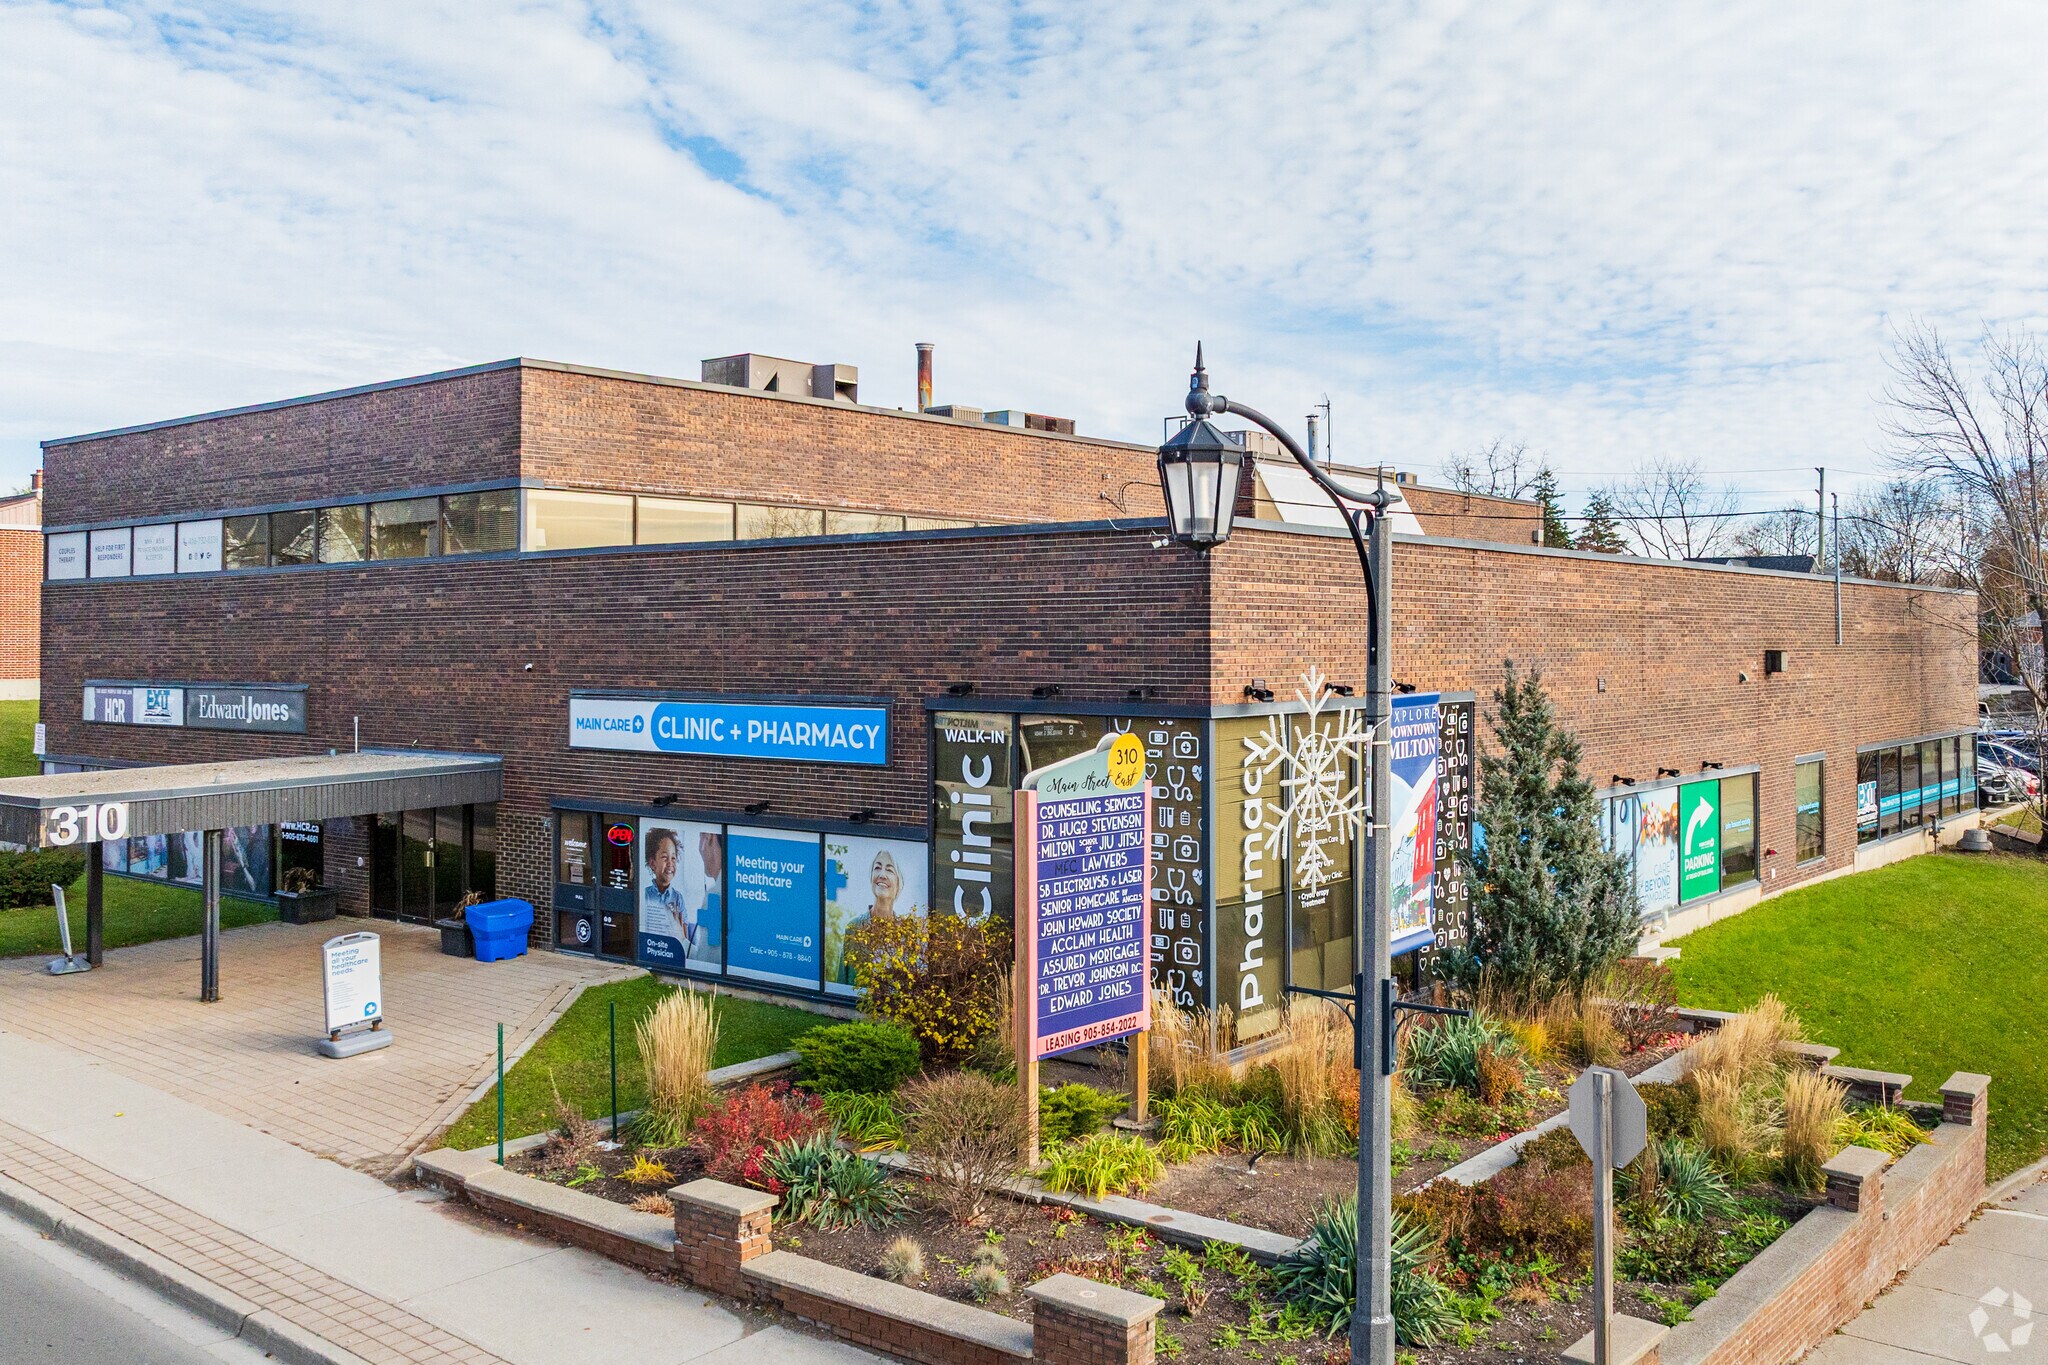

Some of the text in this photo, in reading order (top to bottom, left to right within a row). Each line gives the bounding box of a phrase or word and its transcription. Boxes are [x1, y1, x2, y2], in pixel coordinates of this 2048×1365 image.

[147, 689, 171, 709] EXIT
[104, 698, 126, 723] HCR
[1393, 706, 1437, 723] XPLORE
[576, 717, 631, 731] MAIN CARE
[658, 716, 724, 742] CLINIC
[748, 720, 880, 749] PHARMACY
[944, 728, 1005, 744] WALK-IN
[1116, 748, 1138, 765] 310
[1046, 767, 1138, 794] Main Street East
[1858, 781, 1877, 810] EXIT
[1040, 796, 1143, 819] COUNSELLING SERVICES
[49, 802, 127, 846] 310
[1042, 813, 1142, 839] DR. HUGO STEVENSON
[564, 838, 587, 848] welcome
[609, 828, 634, 842] OPEN
[950, 753, 993, 928] Clinic
[1041, 831, 1143, 859] MILTON SCHOOL JIU JITSU
[1085, 845, 1092, 853] OF
[735, 854, 805, 874] Meeting your
[1054, 852, 1128, 876] MFC LAWYERS
[1653, 861, 1671, 876] CARE
[1684, 851, 1715, 872] PARKING
[735, 870, 792, 888] healthcare
[1239, 736, 1267, 1010] Pharmacy
[1040, 869, 1143, 898] SB ELECTROLYSIS & LASER
[1644, 874, 1671, 893] BEYOND
[735, 888, 770, 902] needs.
[1041, 899, 1072, 916] SENIOR
[1075, 890, 1120, 910] HOMECARE
[1122, 893, 1143, 904] ANGELS
[1041, 905, 1141, 937] JOHN HOWARD SOCIETY
[646, 938, 669, 949] On-site
[775, 933, 789, 941] MAIN
[789, 935, 803, 944] CARE
[1051, 924, 1133, 955] ACCLAIM HEALTH
[331, 948, 359, 958] Meeting
[341, 954, 357, 963] your
[646, 947, 674, 959] Physician
[750, 946, 764, 955] Clinic
[1042, 942, 1141, 976] ASSURED MORTGAGE
[331, 958, 369, 971] healthcare
[1040, 983, 1051, 996] DR.
[1053, 972, 1085, 992] TREVOR
[1089, 962, 1129, 983] JOHNSON
[1050, 980, 1132, 1013] EDWARD JONES
[1045, 1016, 1137, 1051] LEASING 905-854-2022
